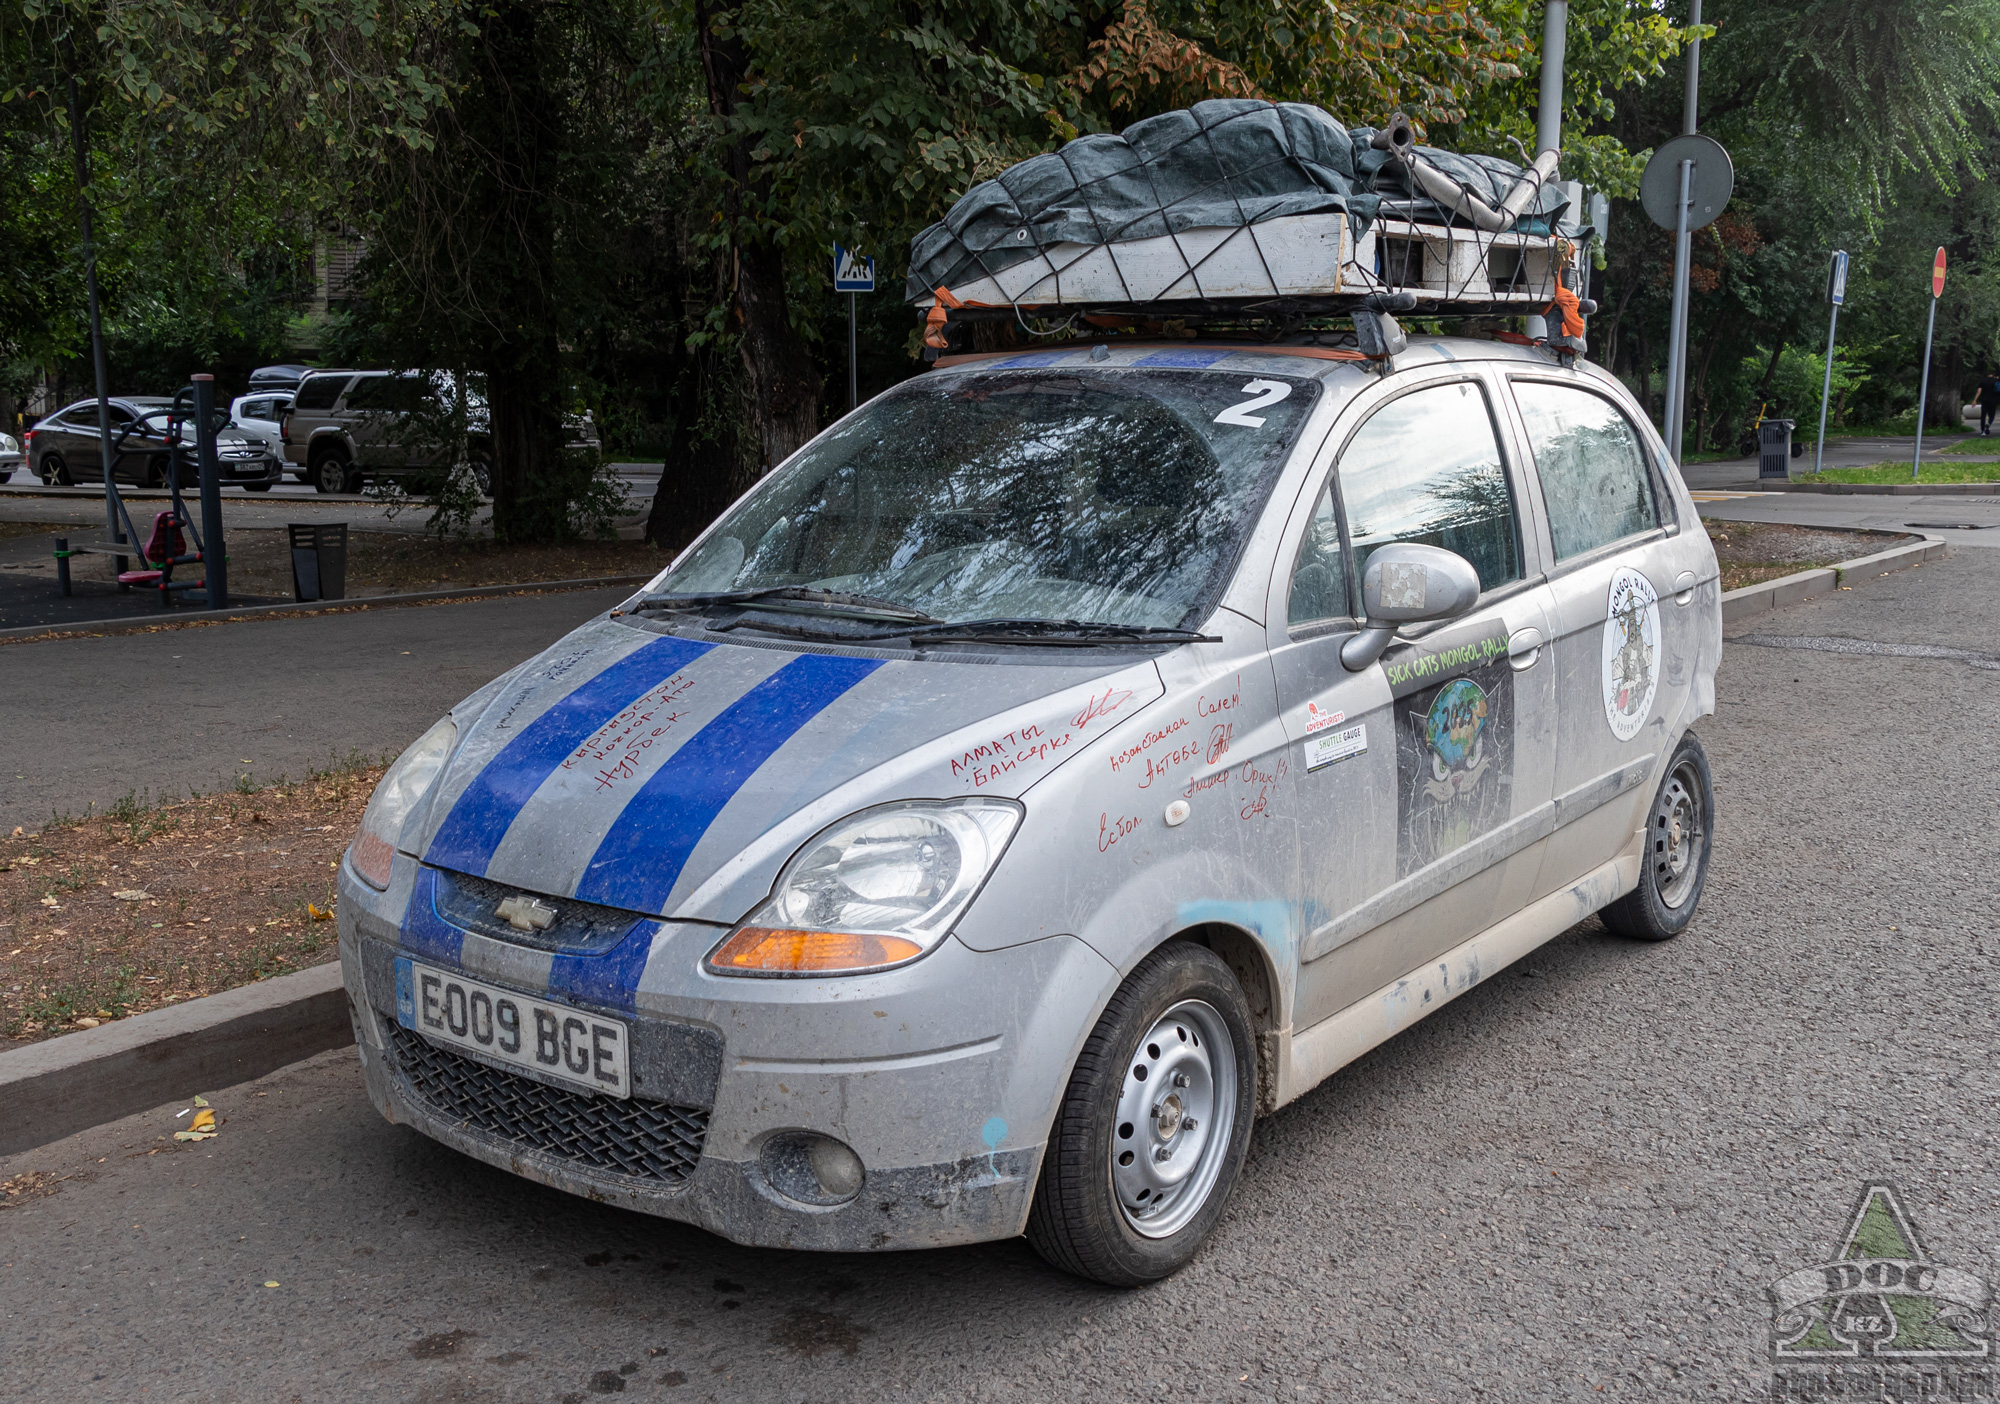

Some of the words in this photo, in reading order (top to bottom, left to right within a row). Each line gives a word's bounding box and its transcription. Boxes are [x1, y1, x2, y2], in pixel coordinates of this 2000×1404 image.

[1213, 378, 1292, 428] 2
[1612, 577, 1633, 618] MONGOL
[1635, 577, 1655, 605] RALLY
[1387, 662, 1414, 686] SICK
[1413, 654, 1440, 677] CATS
[1439, 643, 1482, 670] MONGOL
[1481, 634, 1509, 657] RALLY
[1306, 712, 1344, 732] ADVENTURISTS
[1319, 734, 1342, 750] SHUTTLE
[1342, 727, 1361, 741] GAUGE
[950, 725, 1045, 776] АЛМАТЫ
[533, 1007, 620, 1087] BGE
